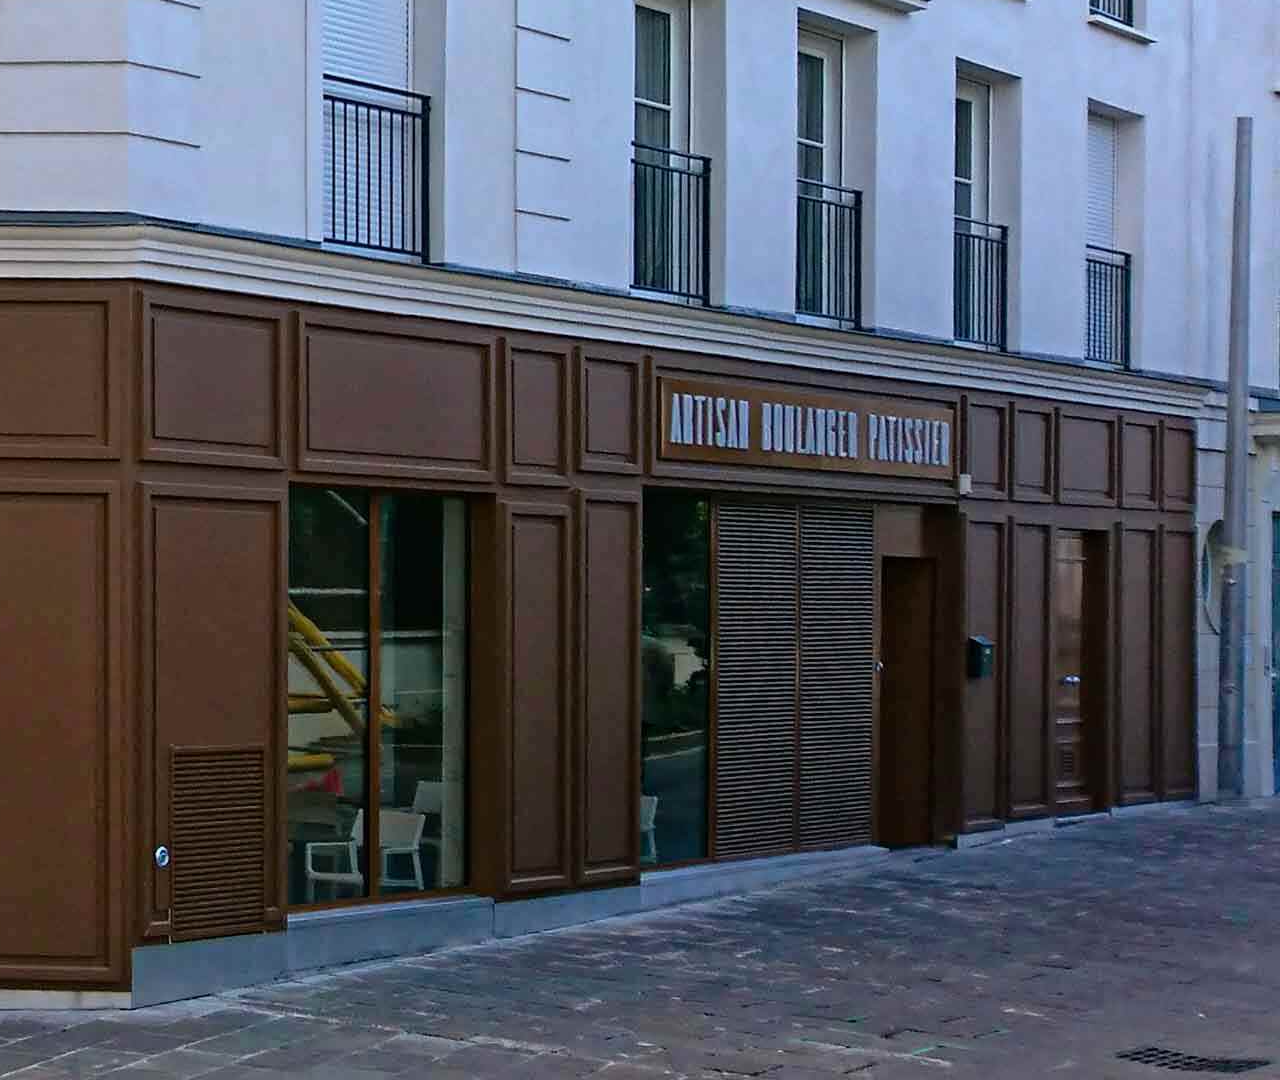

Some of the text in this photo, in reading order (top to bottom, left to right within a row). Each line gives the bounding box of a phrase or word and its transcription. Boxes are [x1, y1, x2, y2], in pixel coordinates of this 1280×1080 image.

[669, 392, 951, 467] ARTISAN BOULANGER PATISSIER
